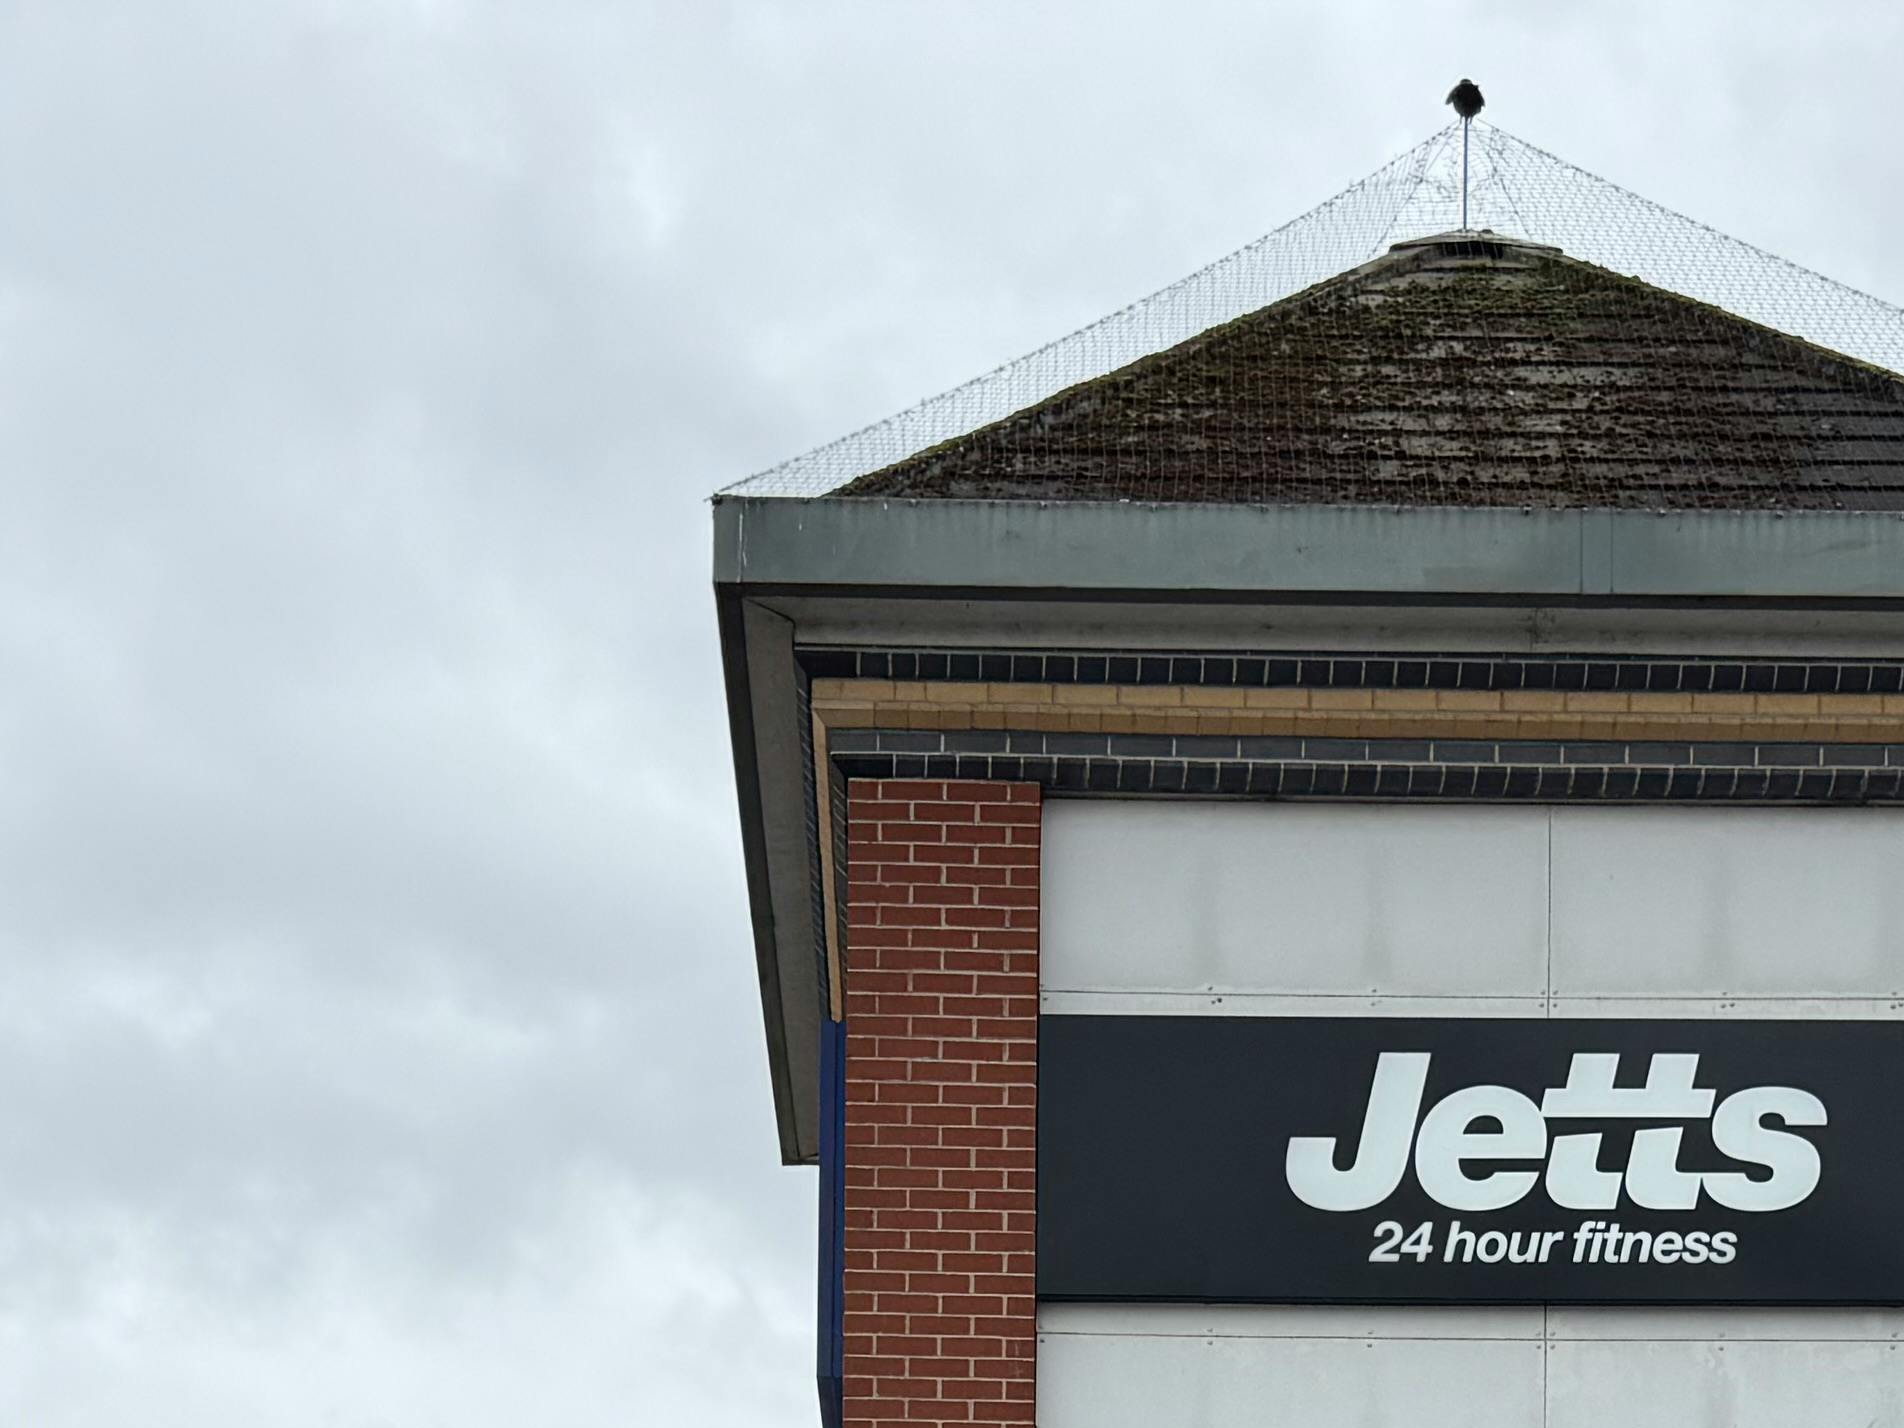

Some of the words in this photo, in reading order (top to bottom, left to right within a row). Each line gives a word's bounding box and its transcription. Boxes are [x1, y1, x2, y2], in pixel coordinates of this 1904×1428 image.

[1285, 1051, 1828, 1212] Jetts
[1368, 1220, 1434, 1263] 24
[1443, 1220, 1564, 1263] hour
[1571, 1220, 1738, 1264] fitness
